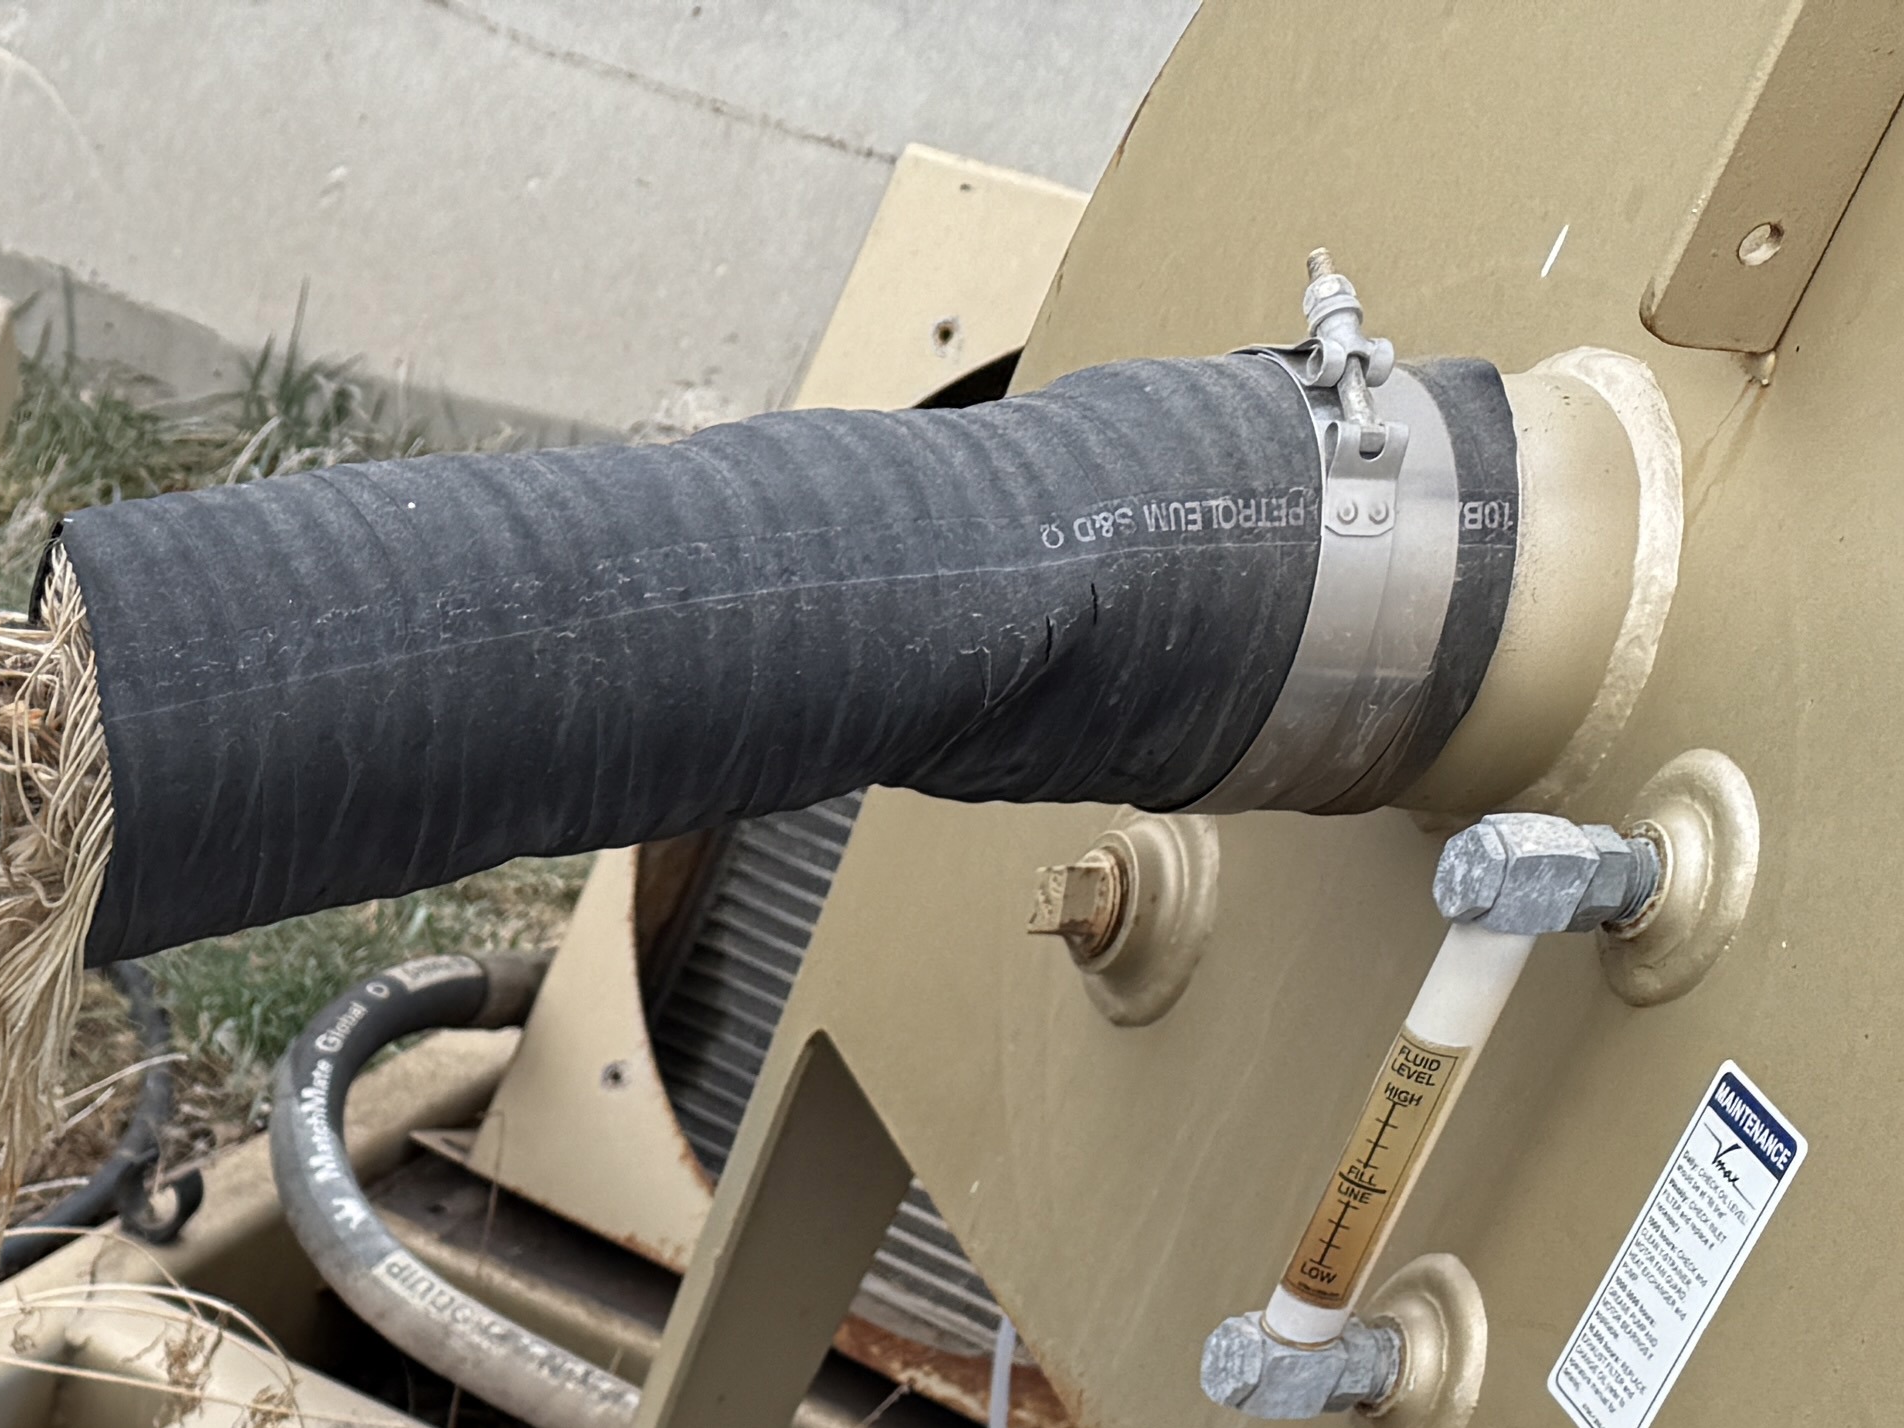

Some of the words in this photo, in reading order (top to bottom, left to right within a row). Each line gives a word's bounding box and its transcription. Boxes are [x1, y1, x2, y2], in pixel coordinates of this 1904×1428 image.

[1072, 505, 1136, 543] S&D
[1144, 495, 1307, 534] PETROLEUM
[315, 1001, 369, 1055] Global
[1391, 1058, 1435, 1087] LEVEL
[1398, 1045, 1441, 1072] FLUID
[1384, 1082, 1423, 1107] HIGH
[299, 1059, 342, 1183] MatchMate
[1714, 1081, 1791, 1171] MAINTENANCE
[1347, 1164, 1377, 1188] FILL
[1337, 1182, 1373, 1204] LINE
[1299, 1261, 1337, 1285] LOW
